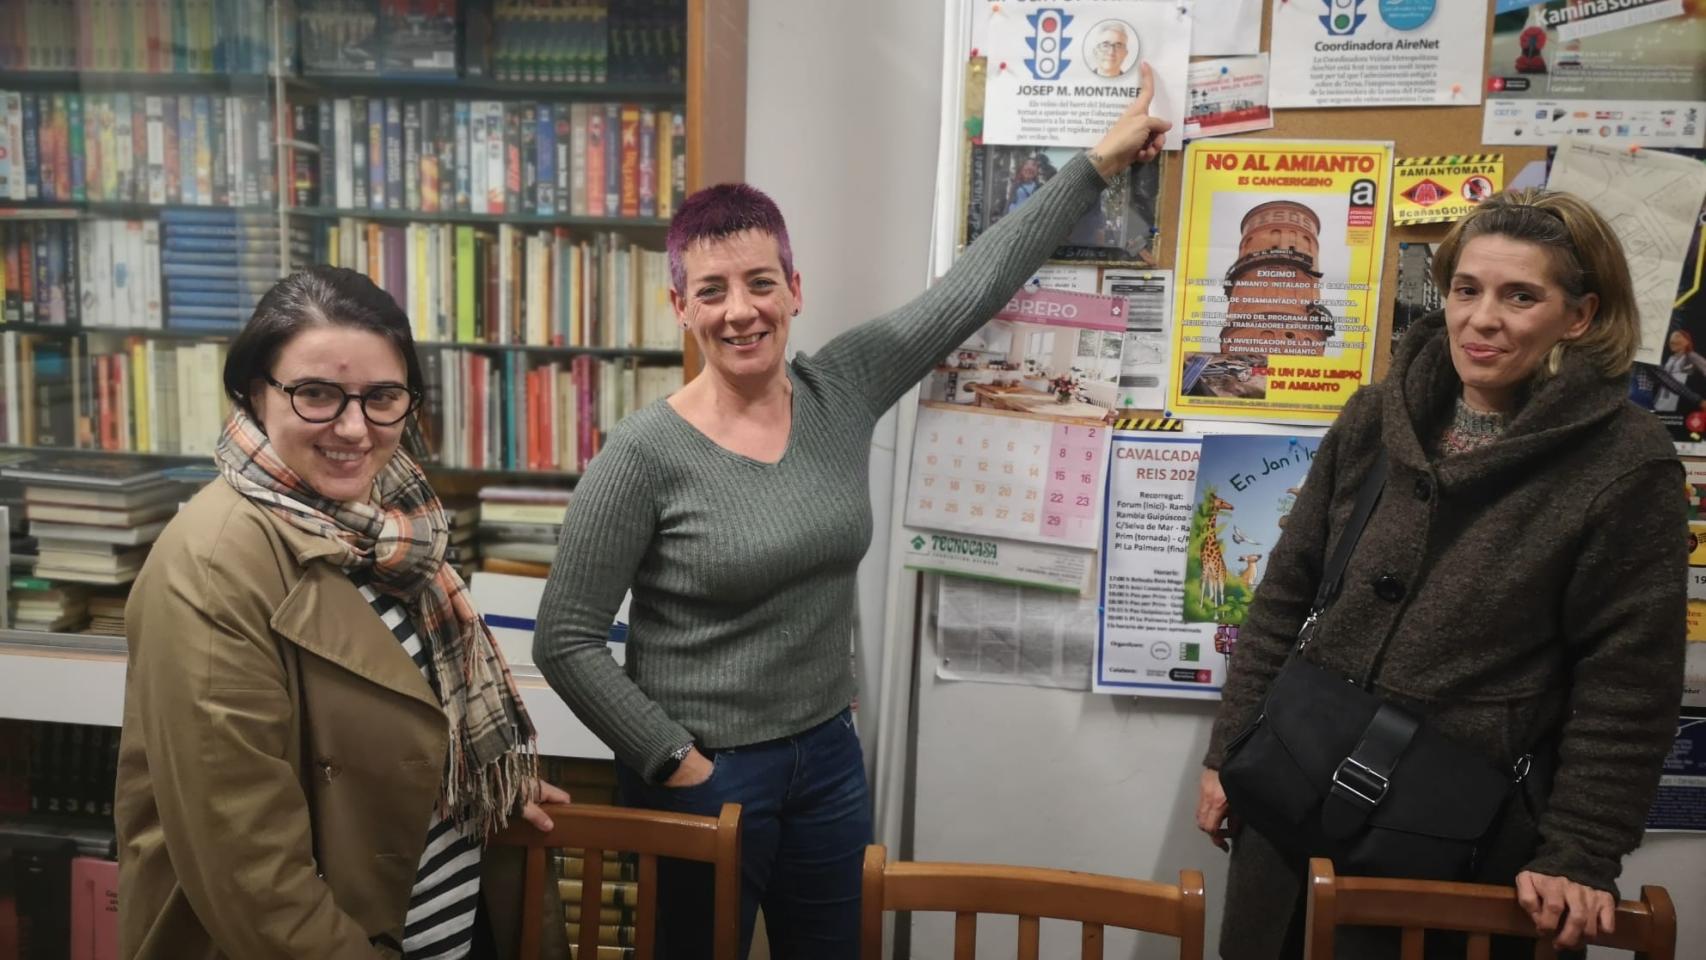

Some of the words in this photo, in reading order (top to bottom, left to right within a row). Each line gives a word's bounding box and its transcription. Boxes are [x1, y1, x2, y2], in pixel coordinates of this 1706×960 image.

[1314, 40, 1393, 52] Coordinadora
[1396, 39, 1440, 50] AireNet
[1016, 85, 1054, 96] JOSEP
[1057, 86, 1071, 97] M.
[1206, 154, 1239, 171] NO
[1243, 155, 1270, 172] AL
[1275, 155, 1375, 173] AMIANTO
[1400, 165, 1496, 177] #AMIANTOMATA
[1252, 177, 1333, 188] CANCERIGENO
[1257, 270, 1296, 278] EXIGIMOS
[1242, 297, 1297, 305] DESAMIANTADO
[1233, 321, 1284, 329] TRABAJADORES
[1278, 367, 1295, 378] UN
[1323, 368, 1362, 380] LIMPIO
[1271, 380, 1284, 391] DE
[1287, 381, 1340, 392] AMIANTO
[1063, 425, 1069, 435] 1
[1087, 428, 1096, 438] 2
[956, 435, 963, 445] 4
[1059, 448, 1066, 458] 8
[1085, 450, 1093, 461] 9
[1116, 447, 1201, 463] CAVALCADA
[978, 461, 988, 472] 12
[1003, 464, 1014, 474] 13
[1029, 467, 1039, 477] 14
[1055, 471, 1066, 481] 15
[1080, 474, 1091, 484] 16
[1137, 468, 1166, 480] REIS
[1170, 468, 1195, 481] 202
[1229, 473, 1256, 492] En
[1262, 457, 1290, 476] Jan
[1294, 449, 1300, 462] i
[924, 477, 935, 487] 17
[999, 486, 1012, 497] 20
[1025, 490, 1037, 500] 21
[1050, 493, 1064, 504] 22
[1075, 496, 1089, 507] 23
[1140, 491, 1184, 501] Recorregut:
[1117, 500, 1142, 508] Forum
[996, 509, 1009, 519] 27
[1021, 512, 1035, 523] 28
[1047, 515, 1061, 526] 29
[1117, 511, 1145, 519] Rambla
[1135, 534, 1170, 543] (tornada)
[931, 535, 998, 560] TECNOCASA
[1134, 543, 1165, 552] Palmera
[48, 797, 60, 811] 2
[66, 798, 78, 812] 3
